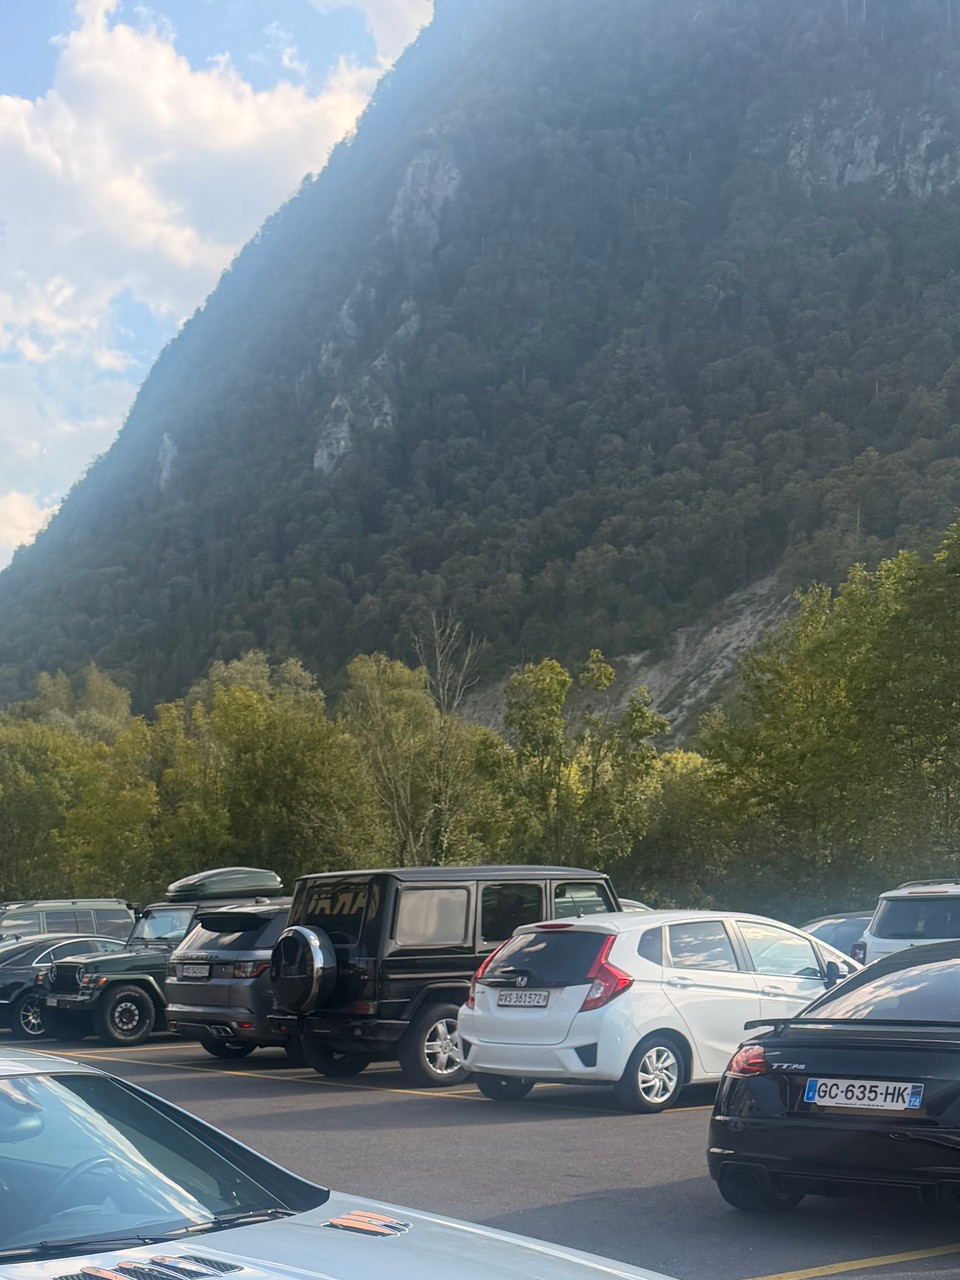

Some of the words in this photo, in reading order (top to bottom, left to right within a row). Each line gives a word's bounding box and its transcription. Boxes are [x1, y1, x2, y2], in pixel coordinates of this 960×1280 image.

[771, 1062, 791, 1070] TT
[817, 1082, 909, 1104] GC-635-HK
[909, 1097, 920, 1107] 74
